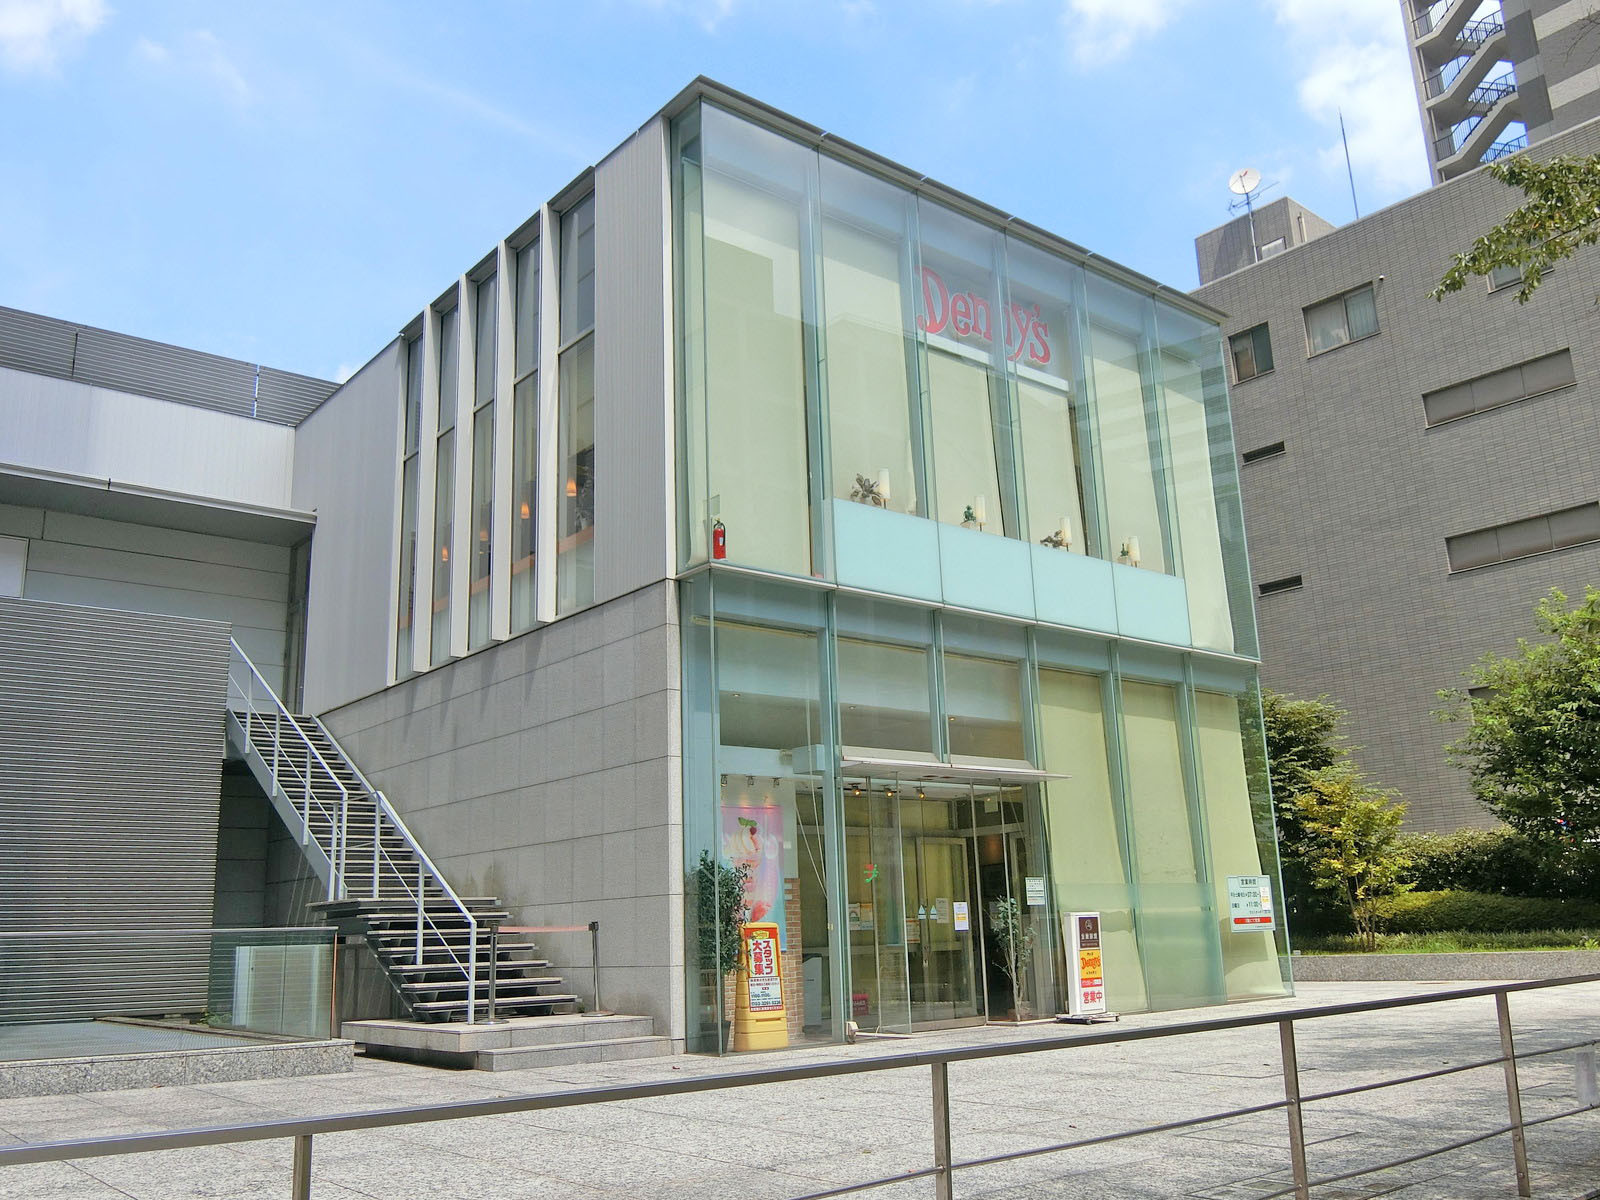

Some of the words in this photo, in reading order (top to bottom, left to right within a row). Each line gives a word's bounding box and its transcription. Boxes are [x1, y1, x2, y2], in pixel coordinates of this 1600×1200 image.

[753, 940, 764, 975] 大募集
[763, 940, 773, 975] スタッフ
[1083, 991, 1102, 1003] 営業中
